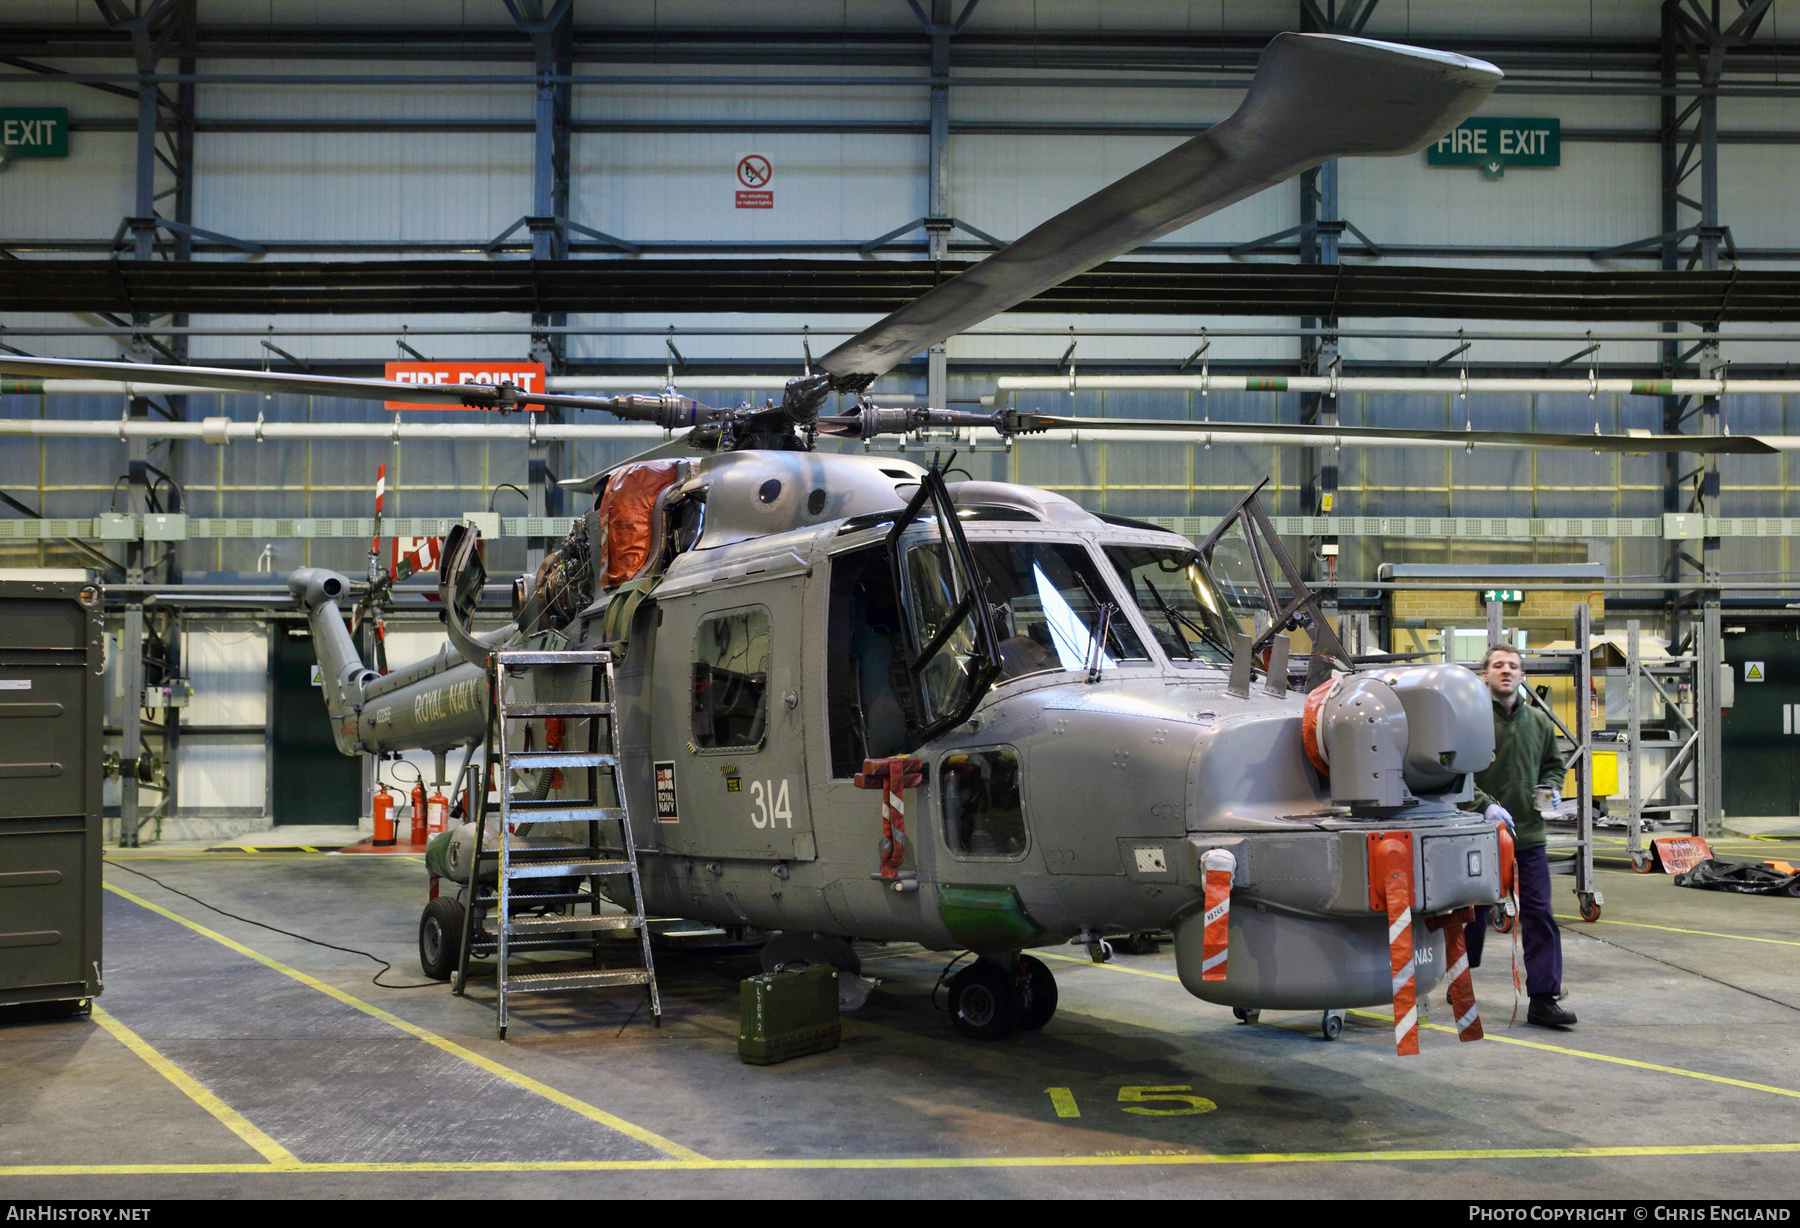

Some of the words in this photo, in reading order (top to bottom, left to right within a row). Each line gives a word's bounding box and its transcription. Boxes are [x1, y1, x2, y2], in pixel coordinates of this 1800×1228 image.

[3, 119, 57, 146] EXIT
[1438, 128, 1488, 154] FIRE
[1500, 129, 1550, 155] EXIT
[414, 688, 447, 725] ROYAL
[449, 677, 478, 715] NAVY
[657, 791, 675, 802] ROYAL
[658, 801, 675, 813] NAVY
[750, 778, 793, 830] 314
[1669, 838, 1694, 849] FUEL
[1414, 946, 1433, 966] NAS
